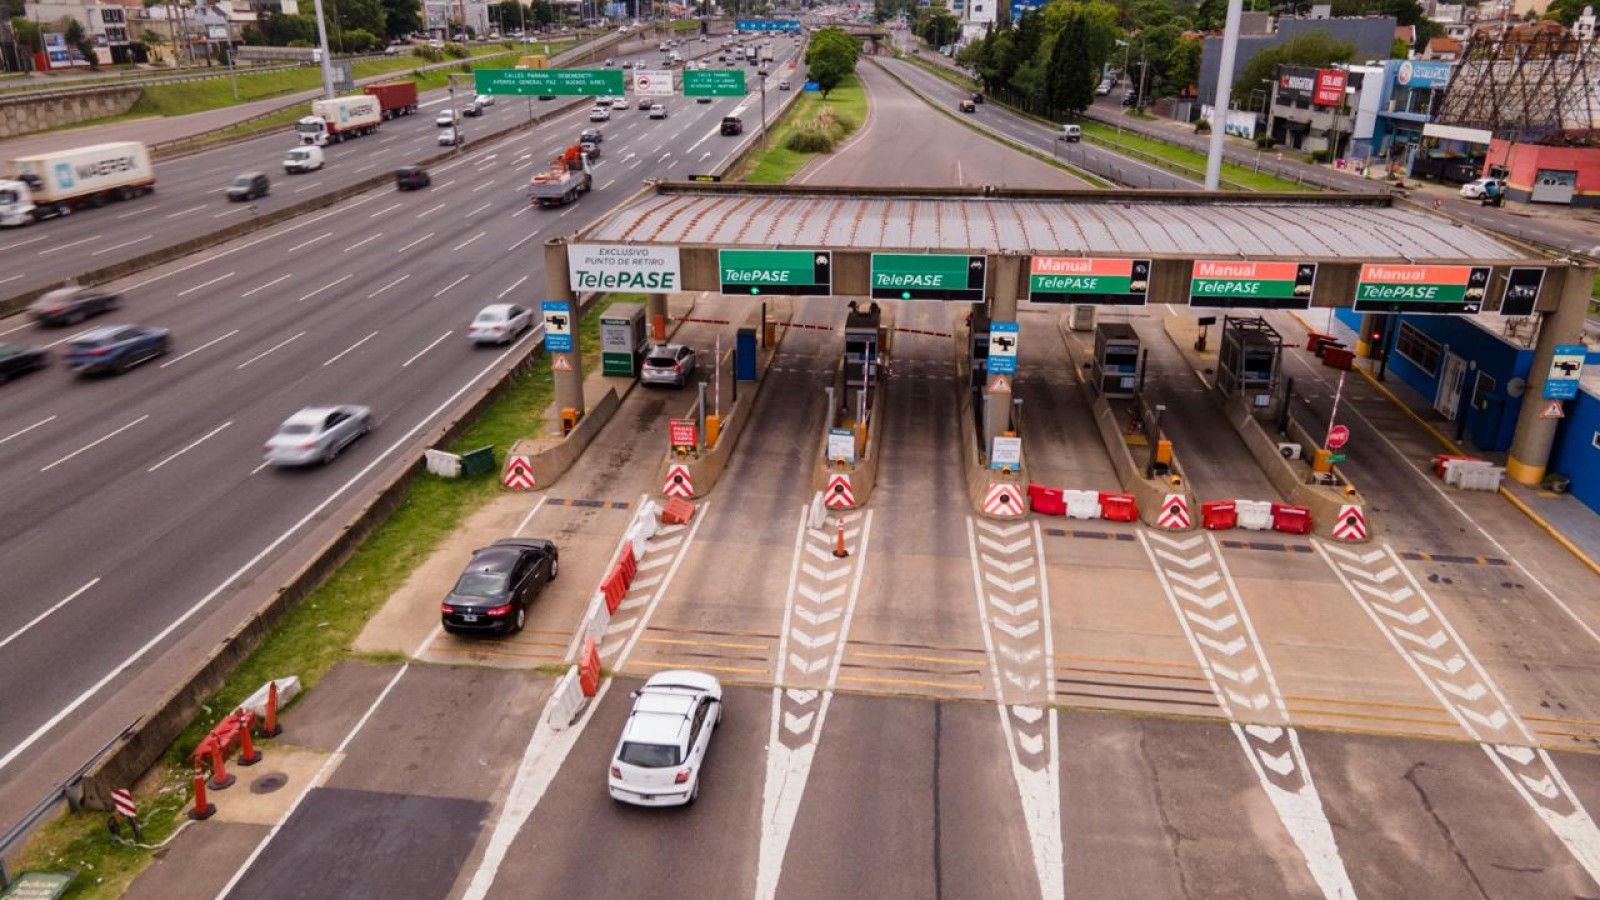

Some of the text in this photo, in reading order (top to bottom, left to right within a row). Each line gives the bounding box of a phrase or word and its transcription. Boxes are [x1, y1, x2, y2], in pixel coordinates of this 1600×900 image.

[599, 248, 649, 256] EXCLUSIVO
[585, 258, 665, 266] PUNTO DE RETIRO
[1038, 258, 1092, 273] Manual
[725, 269, 790, 282] TelePASE
[1200, 263, 1256, 278] Manual
[1367, 267, 1426, 281] Manual
[576, 271, 675, 288] TelePASE
[877, 273, 943, 287] TelePASE
[1038, 277, 1098, 290] TelePASE
[1198, 281, 1260, 294] TelePASE
[1363, 285, 1439, 299] TelePASE
